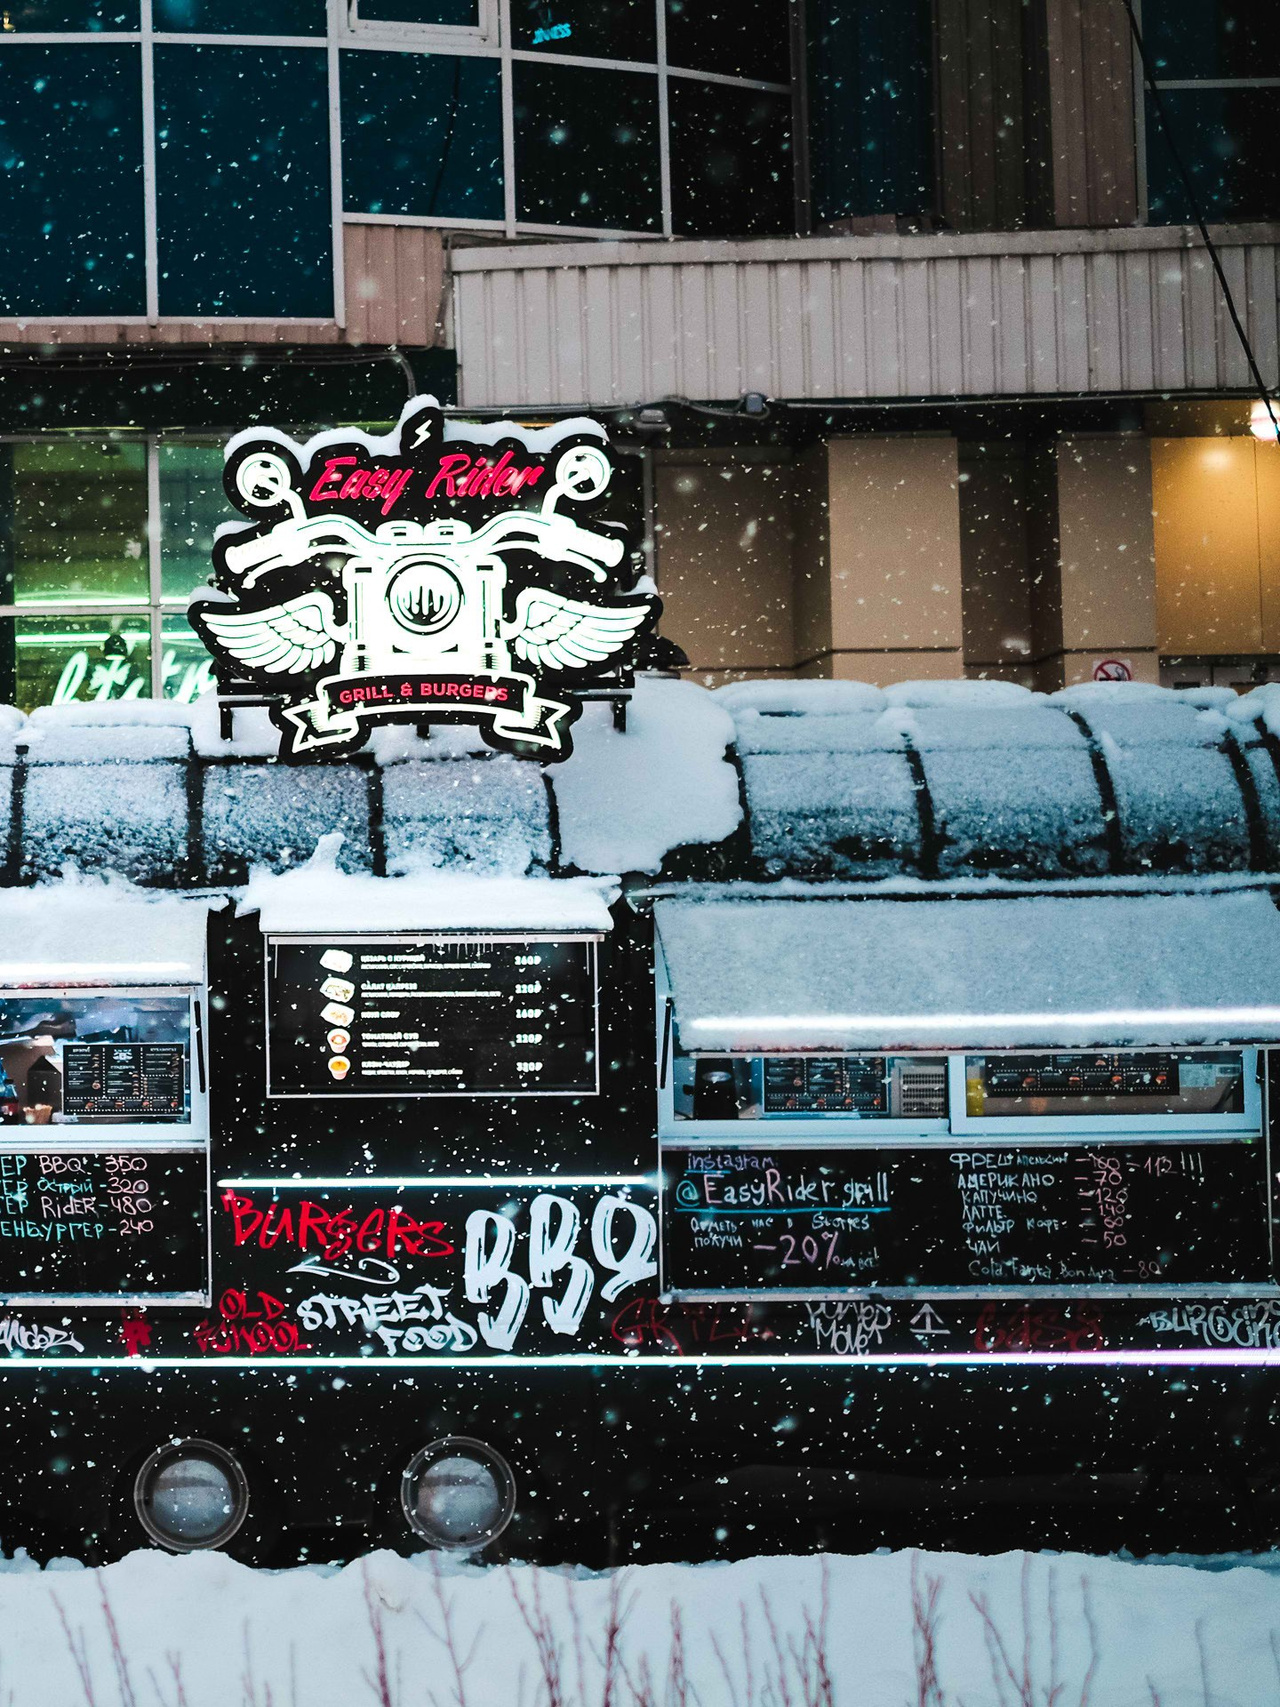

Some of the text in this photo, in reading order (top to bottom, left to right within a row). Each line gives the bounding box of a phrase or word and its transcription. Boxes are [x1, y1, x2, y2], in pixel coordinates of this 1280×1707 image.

[309, 450, 545, 516] Easy Rider
[339, 683, 509, 704] GRILL & BURGERS
[961, 1189, 1037, 1204] КАПУЧИНО
[463, 1193, 658, 1352] BBQ
[219, 1288, 286, 1321] OLD
[296, 1282, 453, 1331] STREET
[374, 1312, 479, 1359] FOOD
